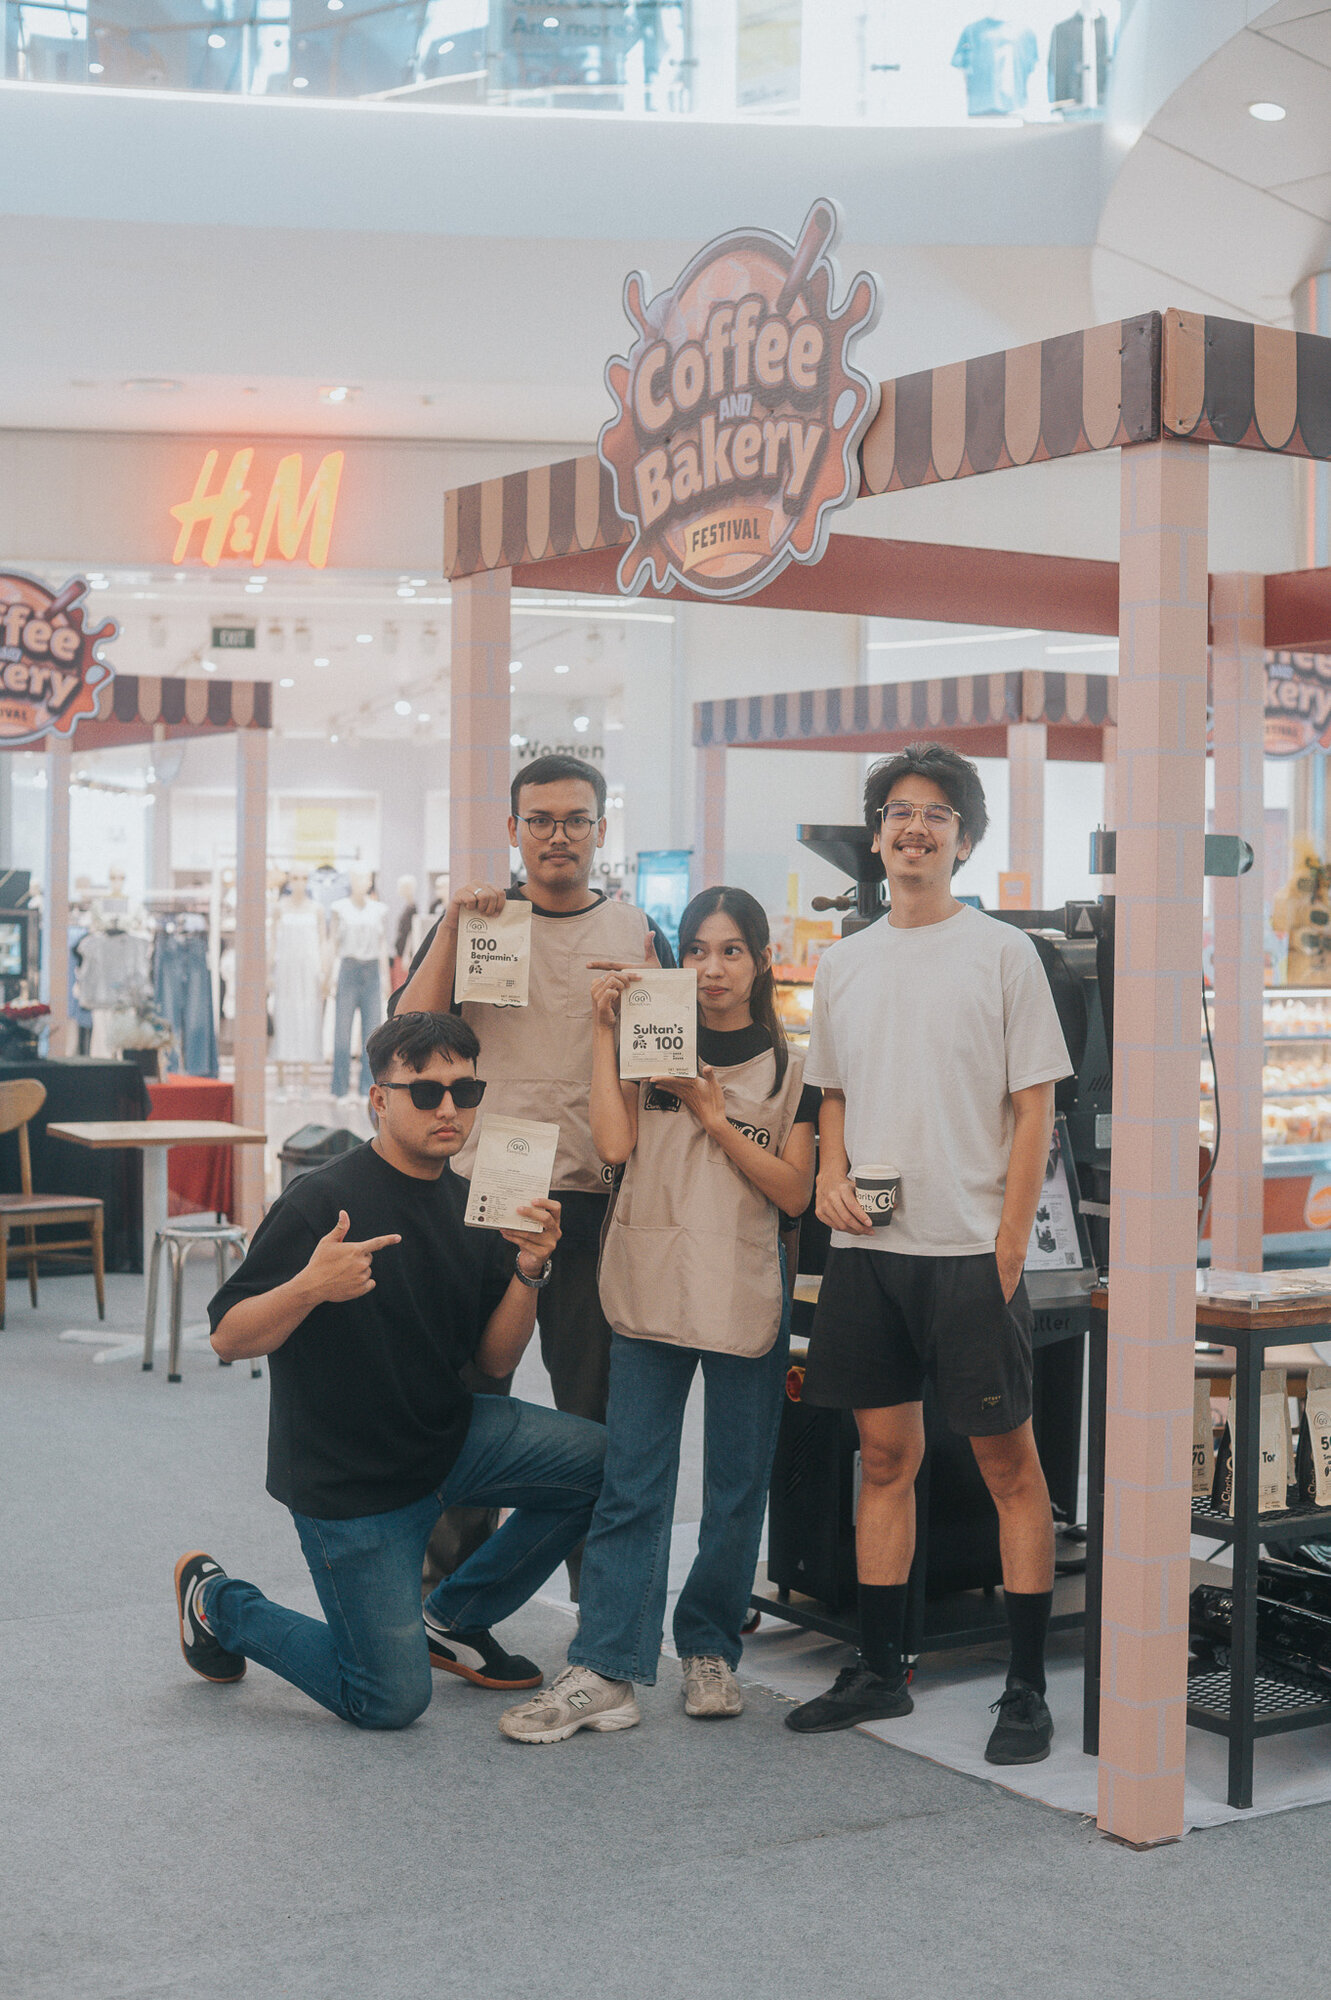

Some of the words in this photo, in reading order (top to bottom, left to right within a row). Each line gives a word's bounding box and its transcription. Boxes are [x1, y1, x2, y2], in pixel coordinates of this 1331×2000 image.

[635, 301, 824, 430] Coffee
[719, 394, 753, 422] AND
[635, 414, 825, 528] Bakery
[170, 448, 344, 568] H&M
[692, 517, 760, 552] FESTIVAL
[516, 740, 604, 758] Women
[470, 938, 497, 951] 100
[470, 951, 519, 962] Benjamin's
[633, 1024, 683, 1035] Sultan's
[655, 1036, 684, 1050] 100
[567, 1689, 592, 1710] N
